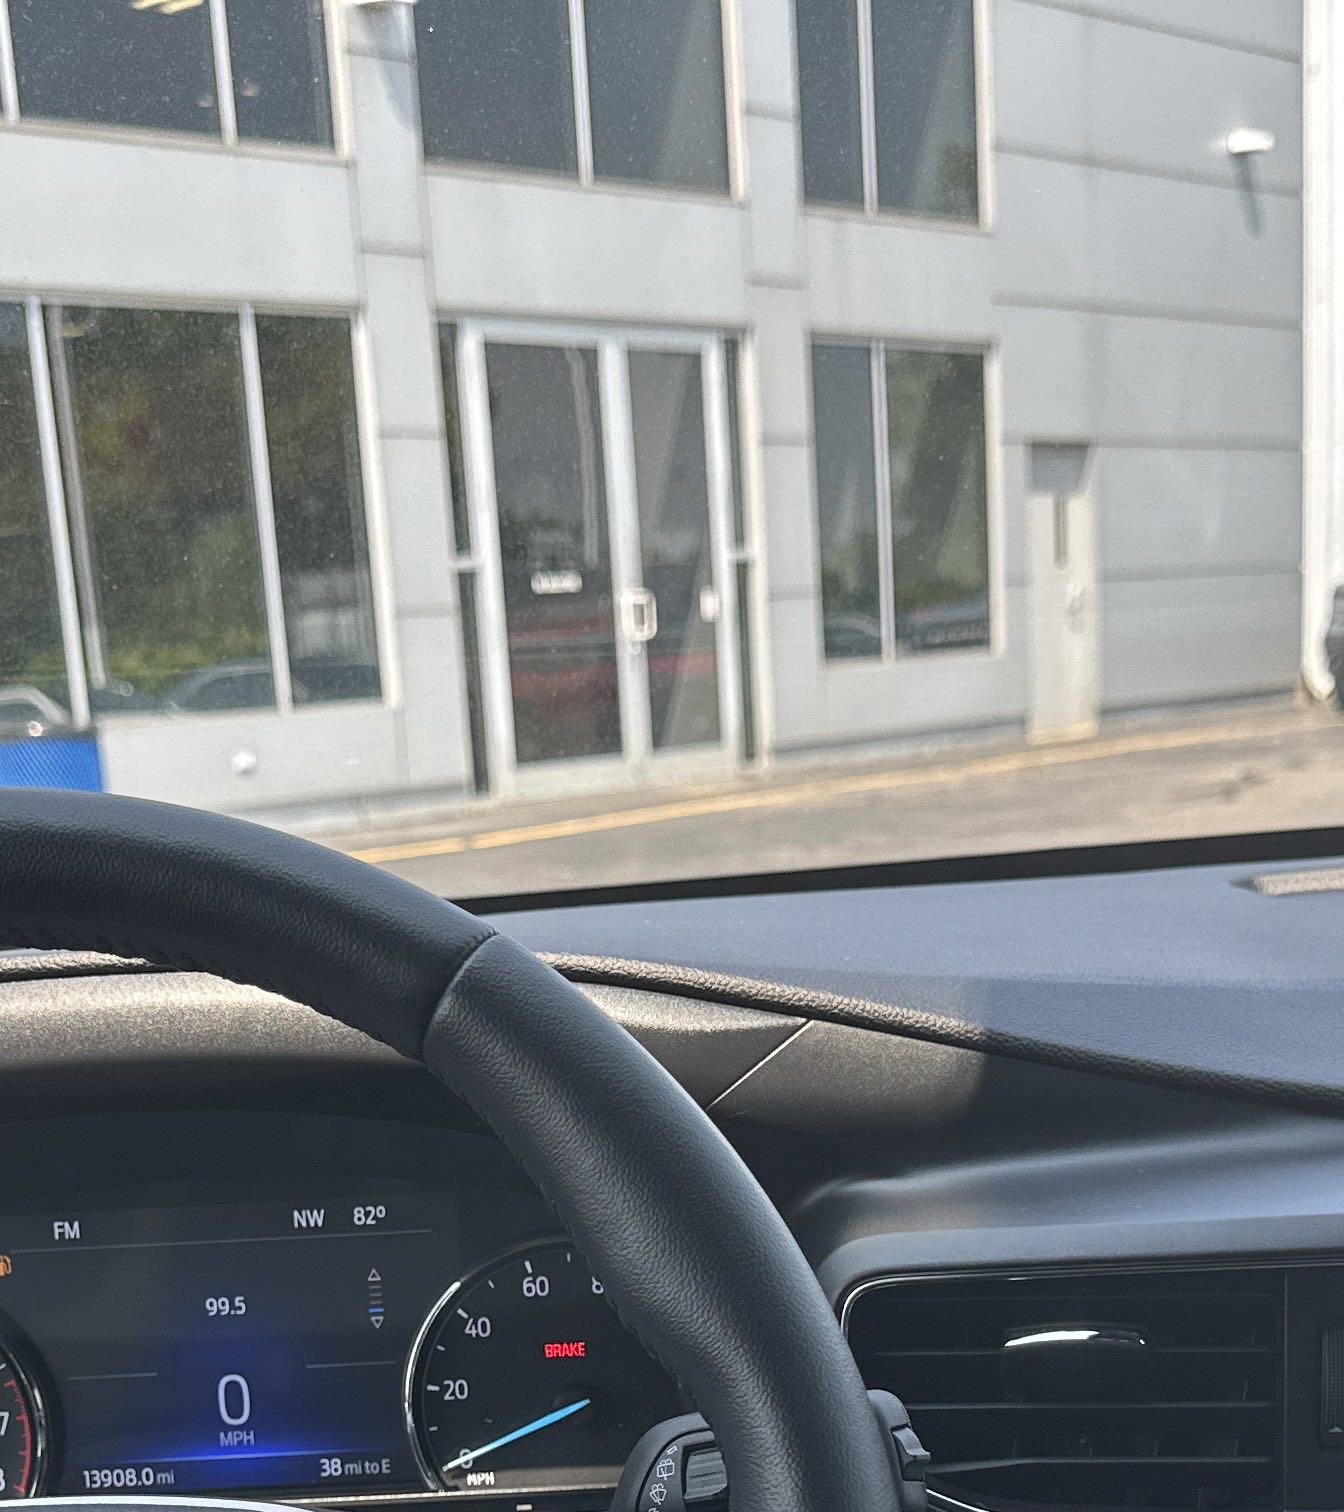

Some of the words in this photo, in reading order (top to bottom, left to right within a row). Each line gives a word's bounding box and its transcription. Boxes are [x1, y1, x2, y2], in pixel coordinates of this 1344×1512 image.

[292, 1209, 326, 1228] NW
[352, 1205, 386, 1226] 82°
[53, 1220, 81, 1240] FM
[522, 1275, 550, 1298] 60
[204, 1296, 247, 1317] 99.5
[464, 1316, 492, 1339] 40
[544, 1341, 587, 1358] BRAKE
[216, 1372, 252, 1427] 0
[442, 1378, 470, 1401] 20
[219, 1431, 255, 1447] MPH
[319, 1458, 343, 1477] 38
[344, 1459, 364, 1475] mi
[364, 1460, 380, 1474] to
[380, 1459, 392, 1474] E
[82, 1468, 154, 1488] 13908.0
[156, 1469, 176, 1486] mi
[466, 1471, 496, 1487] MPH
